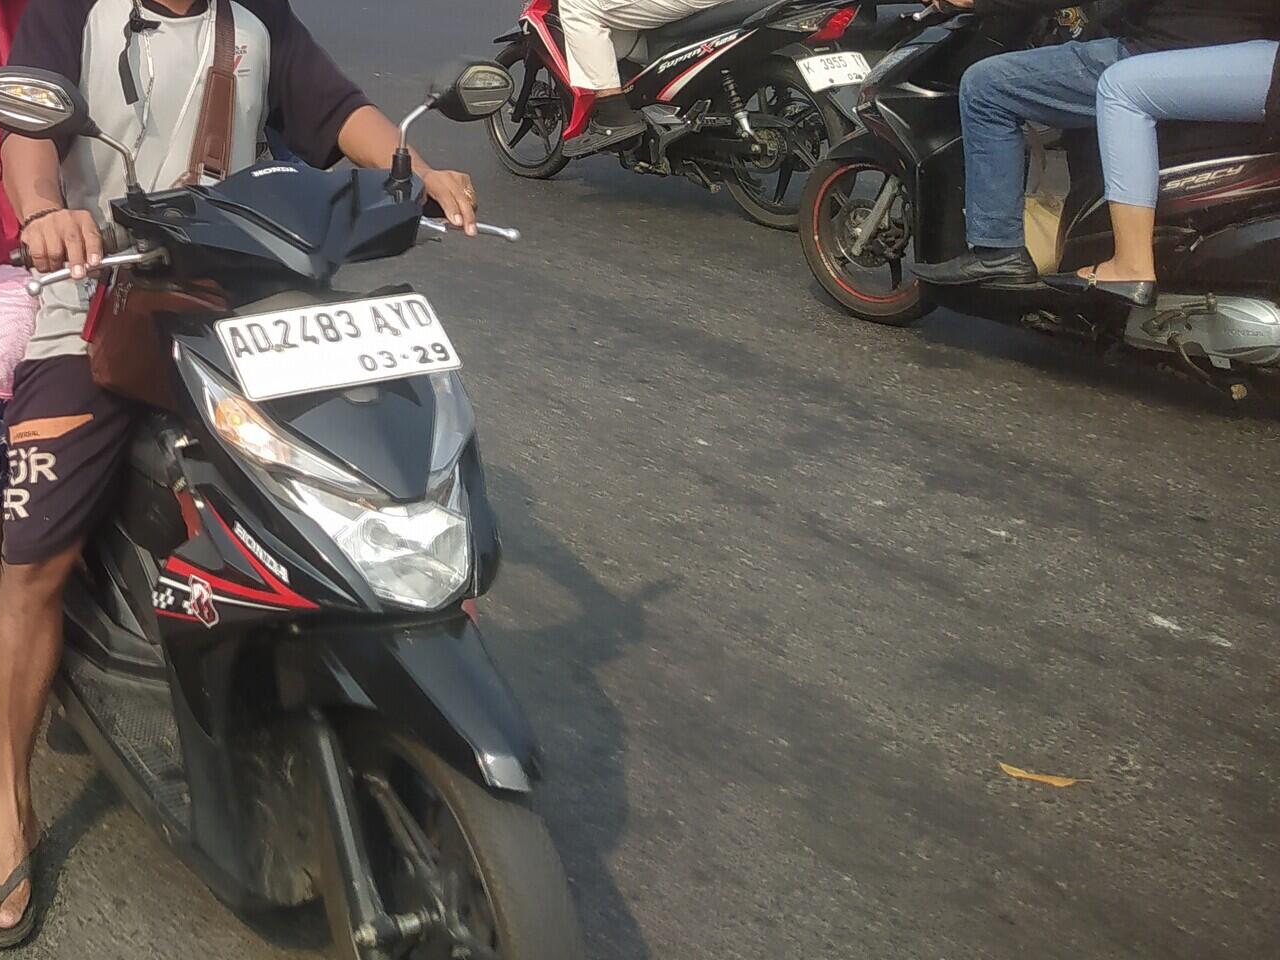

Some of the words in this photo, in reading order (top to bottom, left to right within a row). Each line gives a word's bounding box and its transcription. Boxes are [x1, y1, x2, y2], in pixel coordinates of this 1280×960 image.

[803, 61, 815, 74] K
[820, 55, 848, 70] 3955
[250, 166, 299, 177] HONDA
[228, 322, 272, 358] AD
[273, 309, 363, 349] 2483
[369, 298, 433, 335] AYD
[233, 520, 290, 584] HONDA
